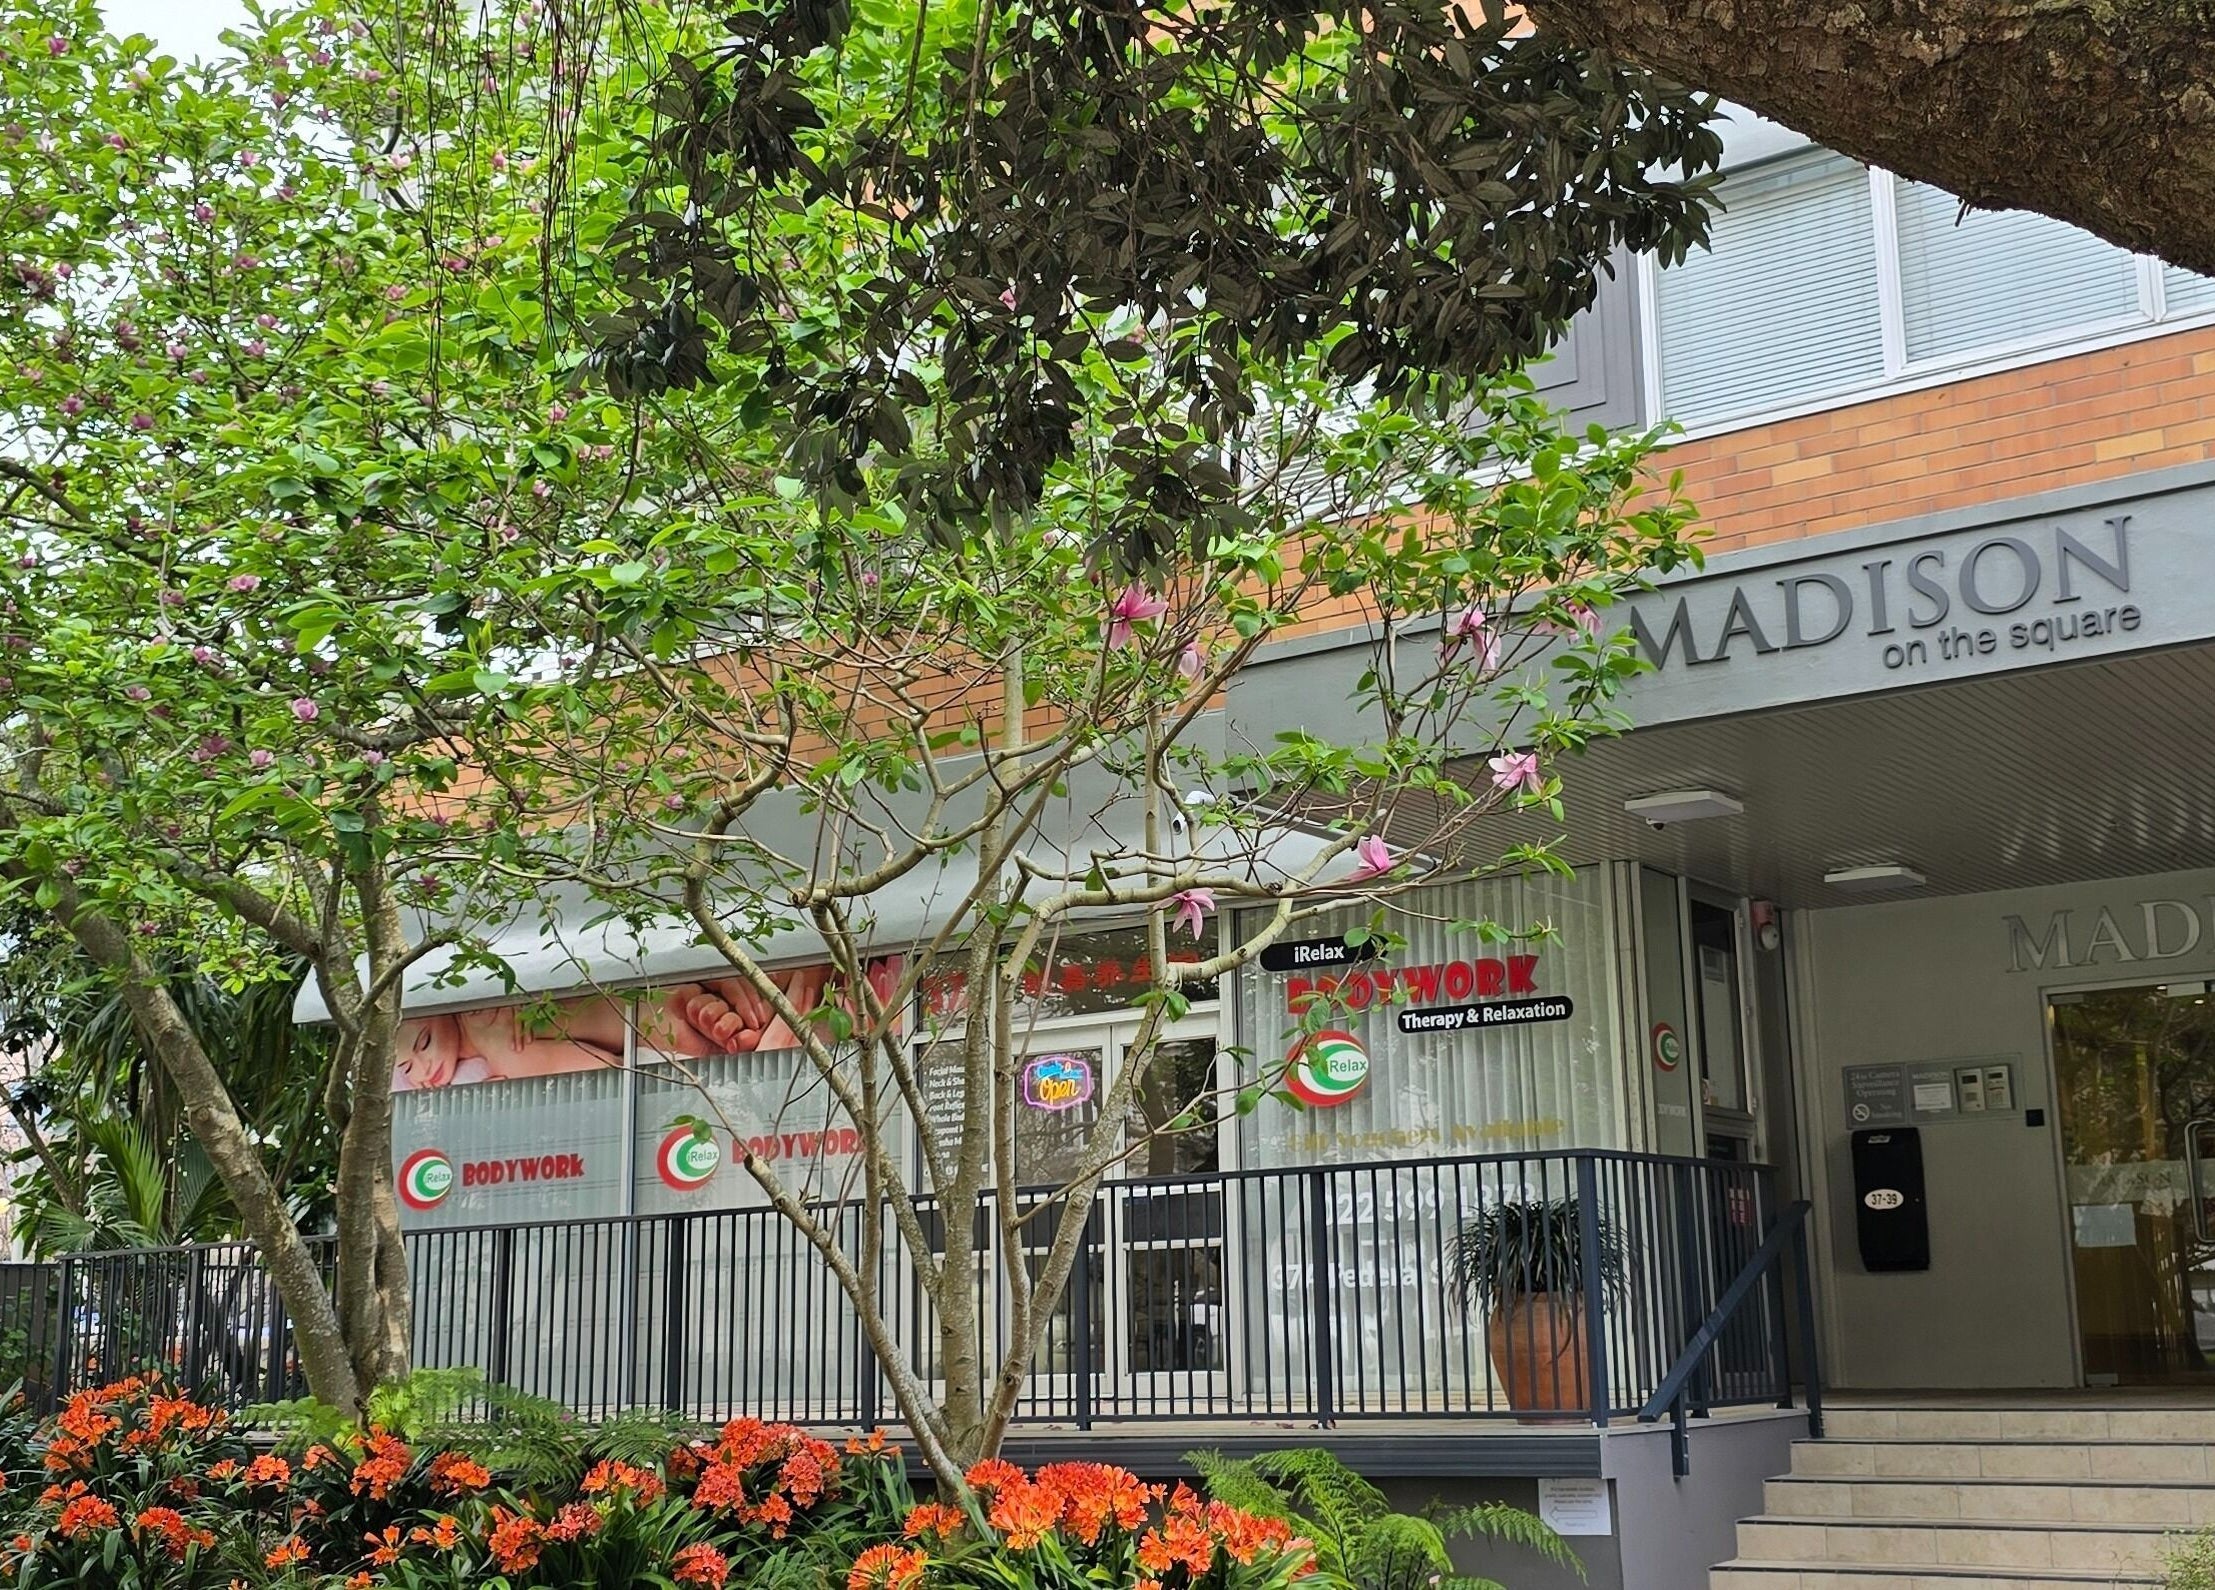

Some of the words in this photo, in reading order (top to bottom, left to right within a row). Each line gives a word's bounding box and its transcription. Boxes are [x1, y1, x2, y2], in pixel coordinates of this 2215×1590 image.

[1624, 514, 2133, 677] MADISON
[1882, 639, 1928, 670] on
[1938, 625, 1997, 661] the
[2011, 604, 2142, 652] square
[1293, 943, 1345, 963] iRelax
[1401, 1011, 1464, 1030] Therapy
[1466, 1008, 1479, 1024] &
[1483, 1001, 1566, 1022] Relaxation
[1329, 1059, 1367, 1073] Relax
[1039, 1077, 1082, 1106] Open
[731, 1127, 866, 1165] BODYWOR
[462, 1153, 585, 1187] BODYWORK
[1327, 1260, 1423, 1289] Federa
